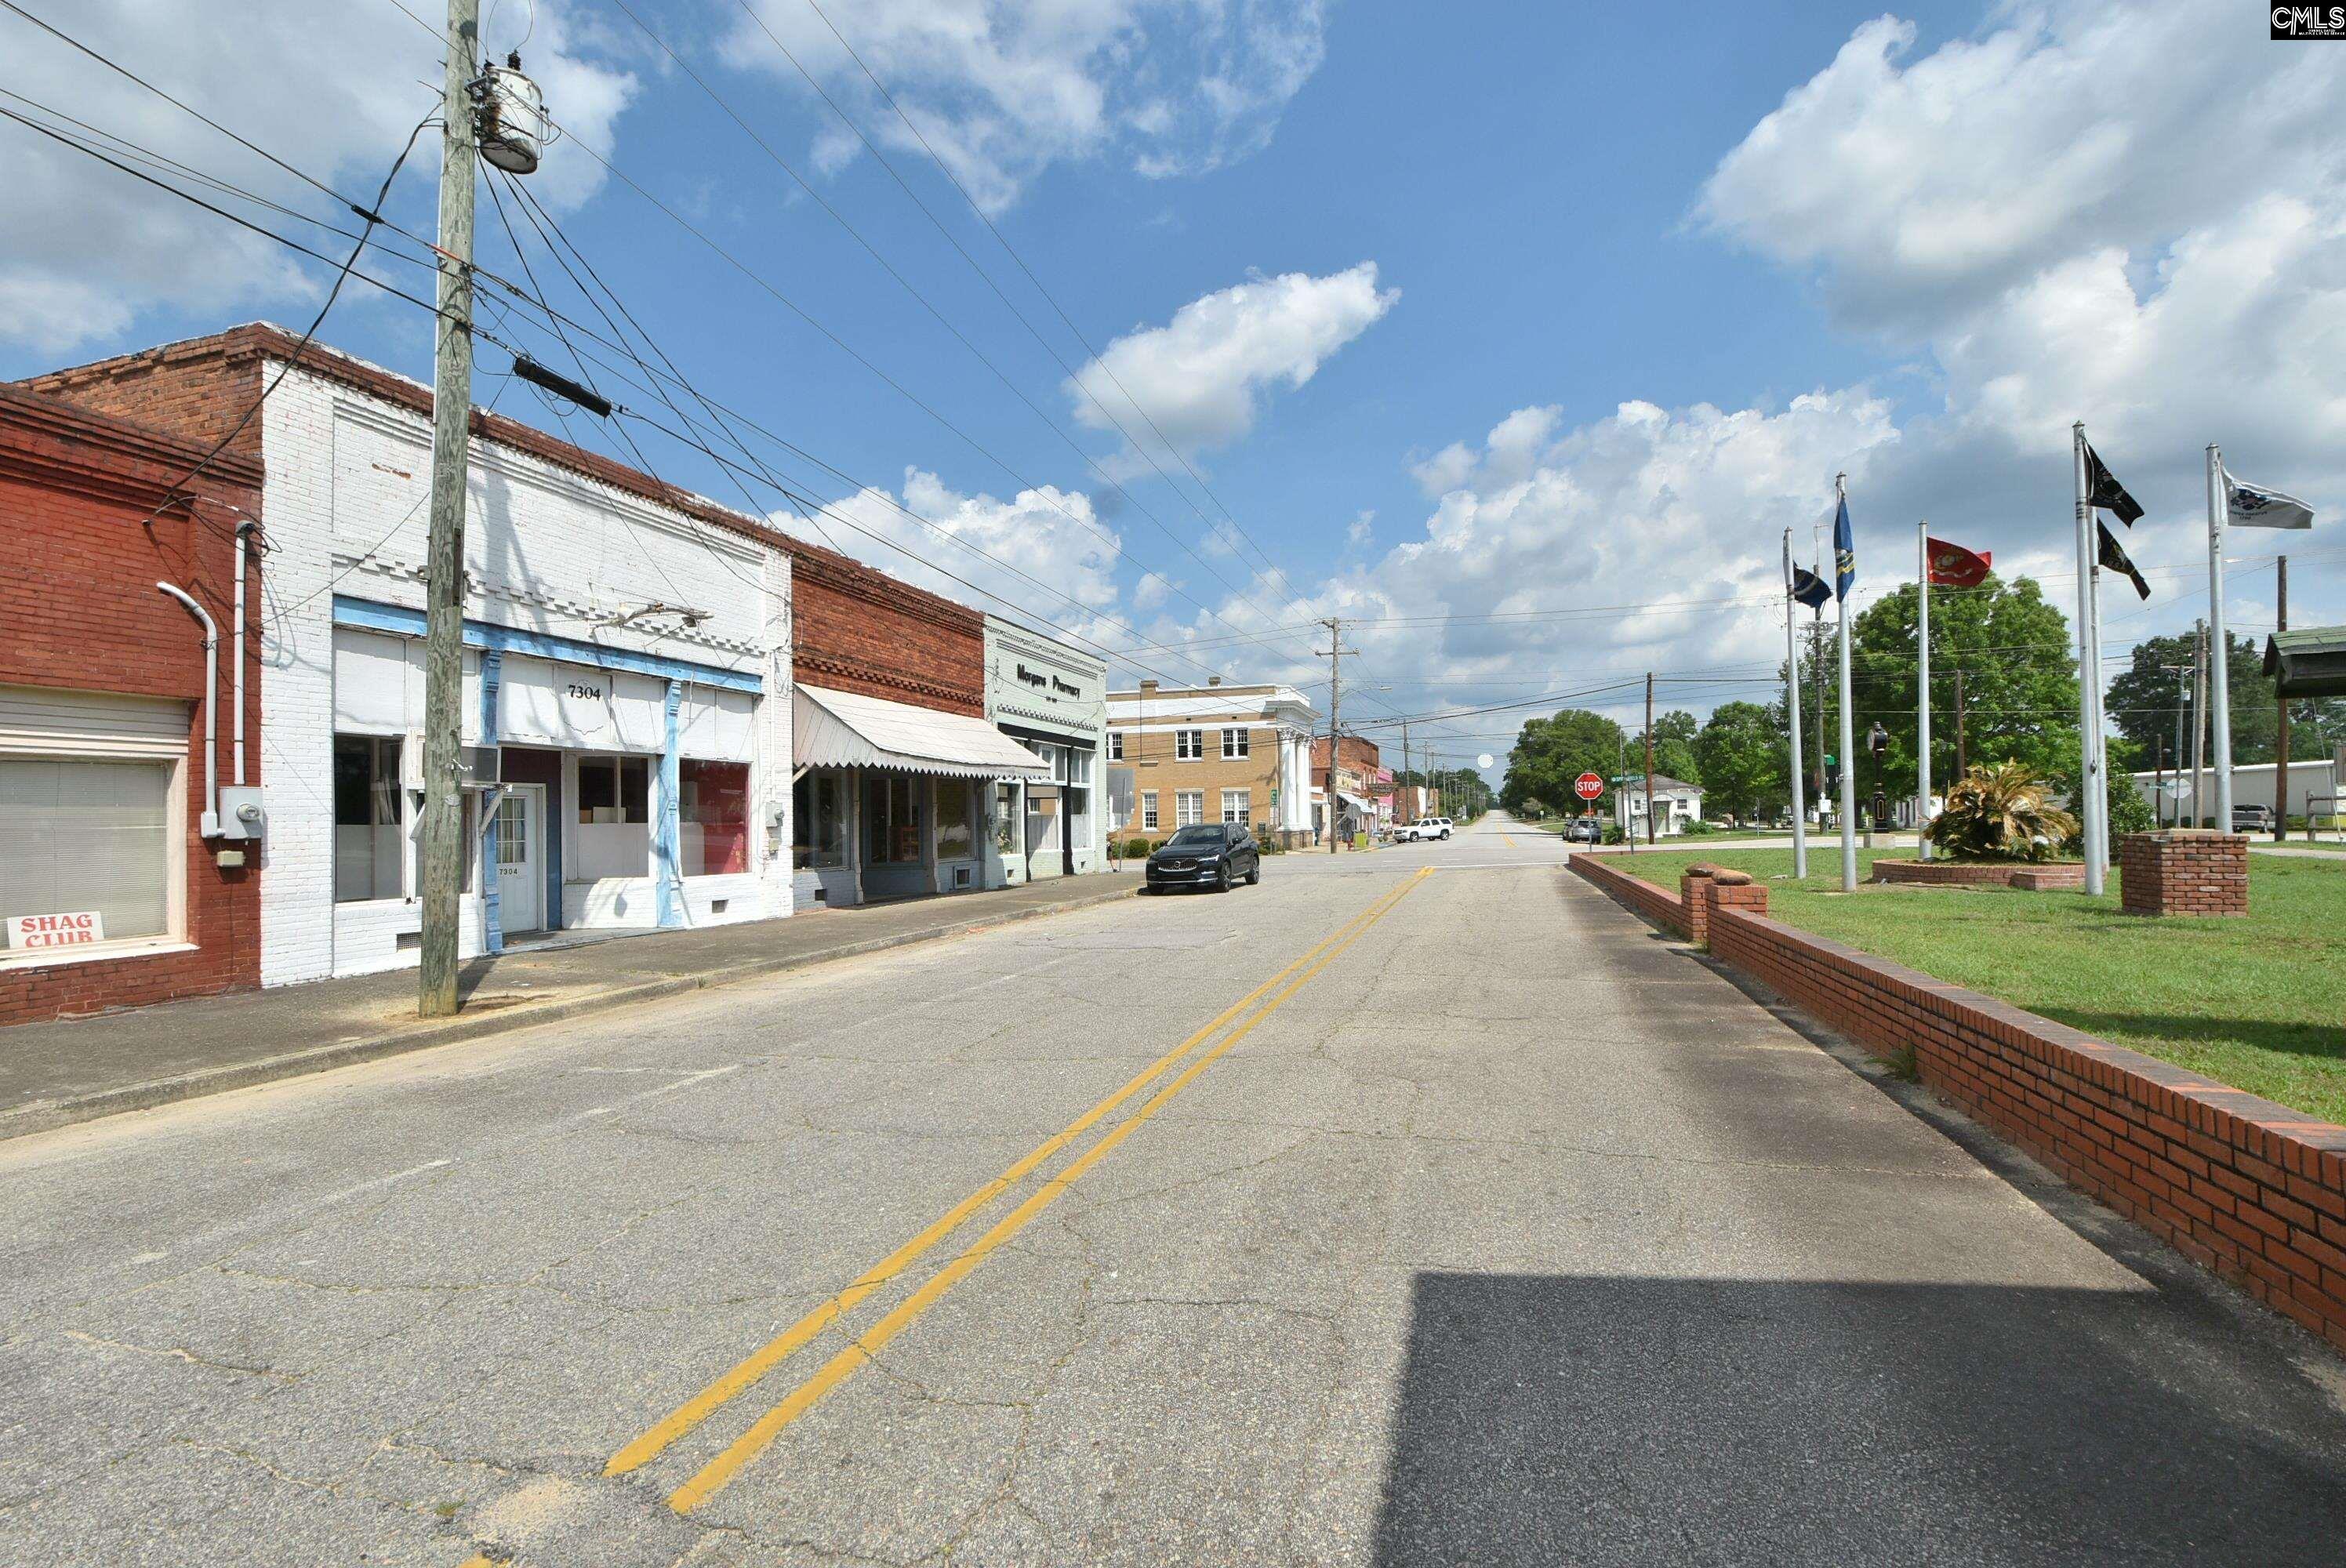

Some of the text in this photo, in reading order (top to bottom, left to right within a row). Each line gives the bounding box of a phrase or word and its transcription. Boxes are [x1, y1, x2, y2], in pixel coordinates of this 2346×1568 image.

[568, 684, 601, 701] 7304
[1052, 675, 1080, 700] Pharmacy
[1578, 781, 1600, 792] STOP
[21, 914, 93, 932] SHAG
[25, 931, 93, 947] CLUB
